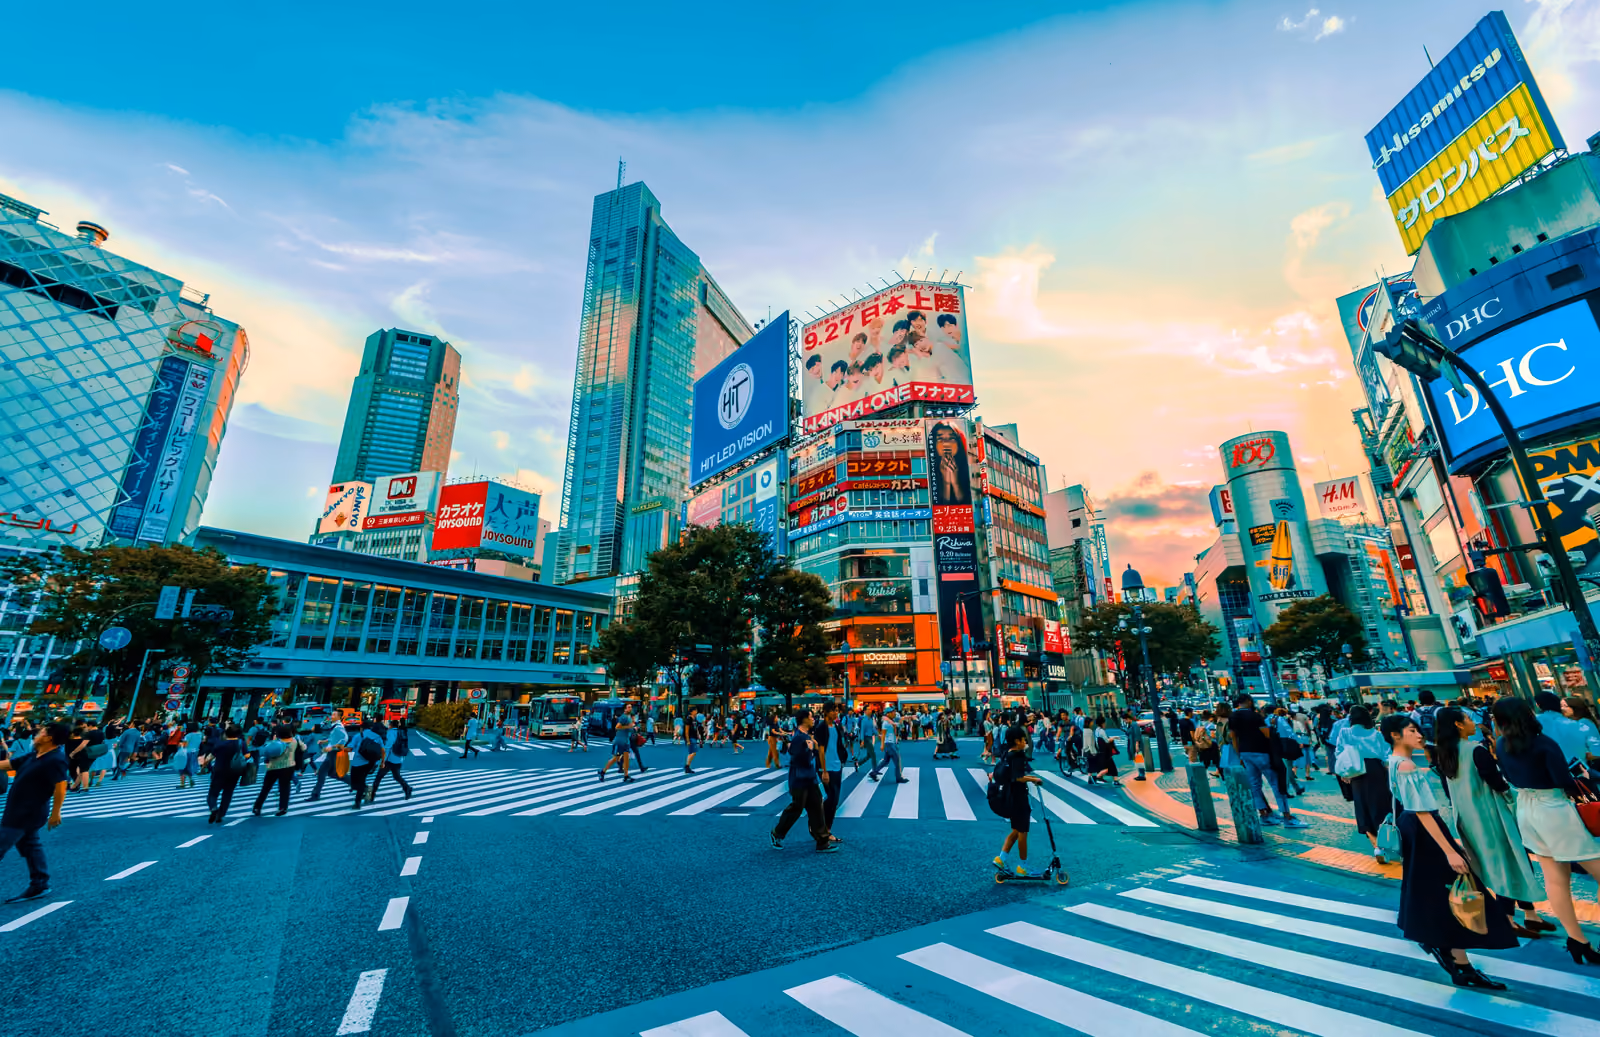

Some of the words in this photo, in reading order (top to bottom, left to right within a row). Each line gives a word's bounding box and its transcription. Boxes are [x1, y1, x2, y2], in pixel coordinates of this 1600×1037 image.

[1372, 48, 1502, 169] Hisamitsu
[1397, 115, 1531, 230] サロンパス
[1445, 297, 1504, 340] DHC
[1444, 338, 1576, 426] DHC
[914, 385, 971, 399] ワナワン
[700, 451, 715, 473] HIT
[717, 442, 736, 464] LED
[737, 420, 773, 449] VISION
[1231, 442, 1275, 468] 109
[848, 460, 909, 472] コンタクト
[1527, 440, 1600, 481] DM
[389, 479, 414, 497] DC
[891, 479, 921, 490] ガスト
[1322, 481, 1355, 504] H&M
[349, 486, 366, 527] SANKYO
[440, 502, 484, 519] カラオケ
[875, 510, 930, 518] 英会話イーオン
[1329, 503, 1350, 512] 150m
[437, 517, 482, 530] JOYSOUND
[483, 529, 534, 549] JOYSOUND
[1272, 565, 1288, 576] BIG
[1047, 664, 1066, 677] LUSH
